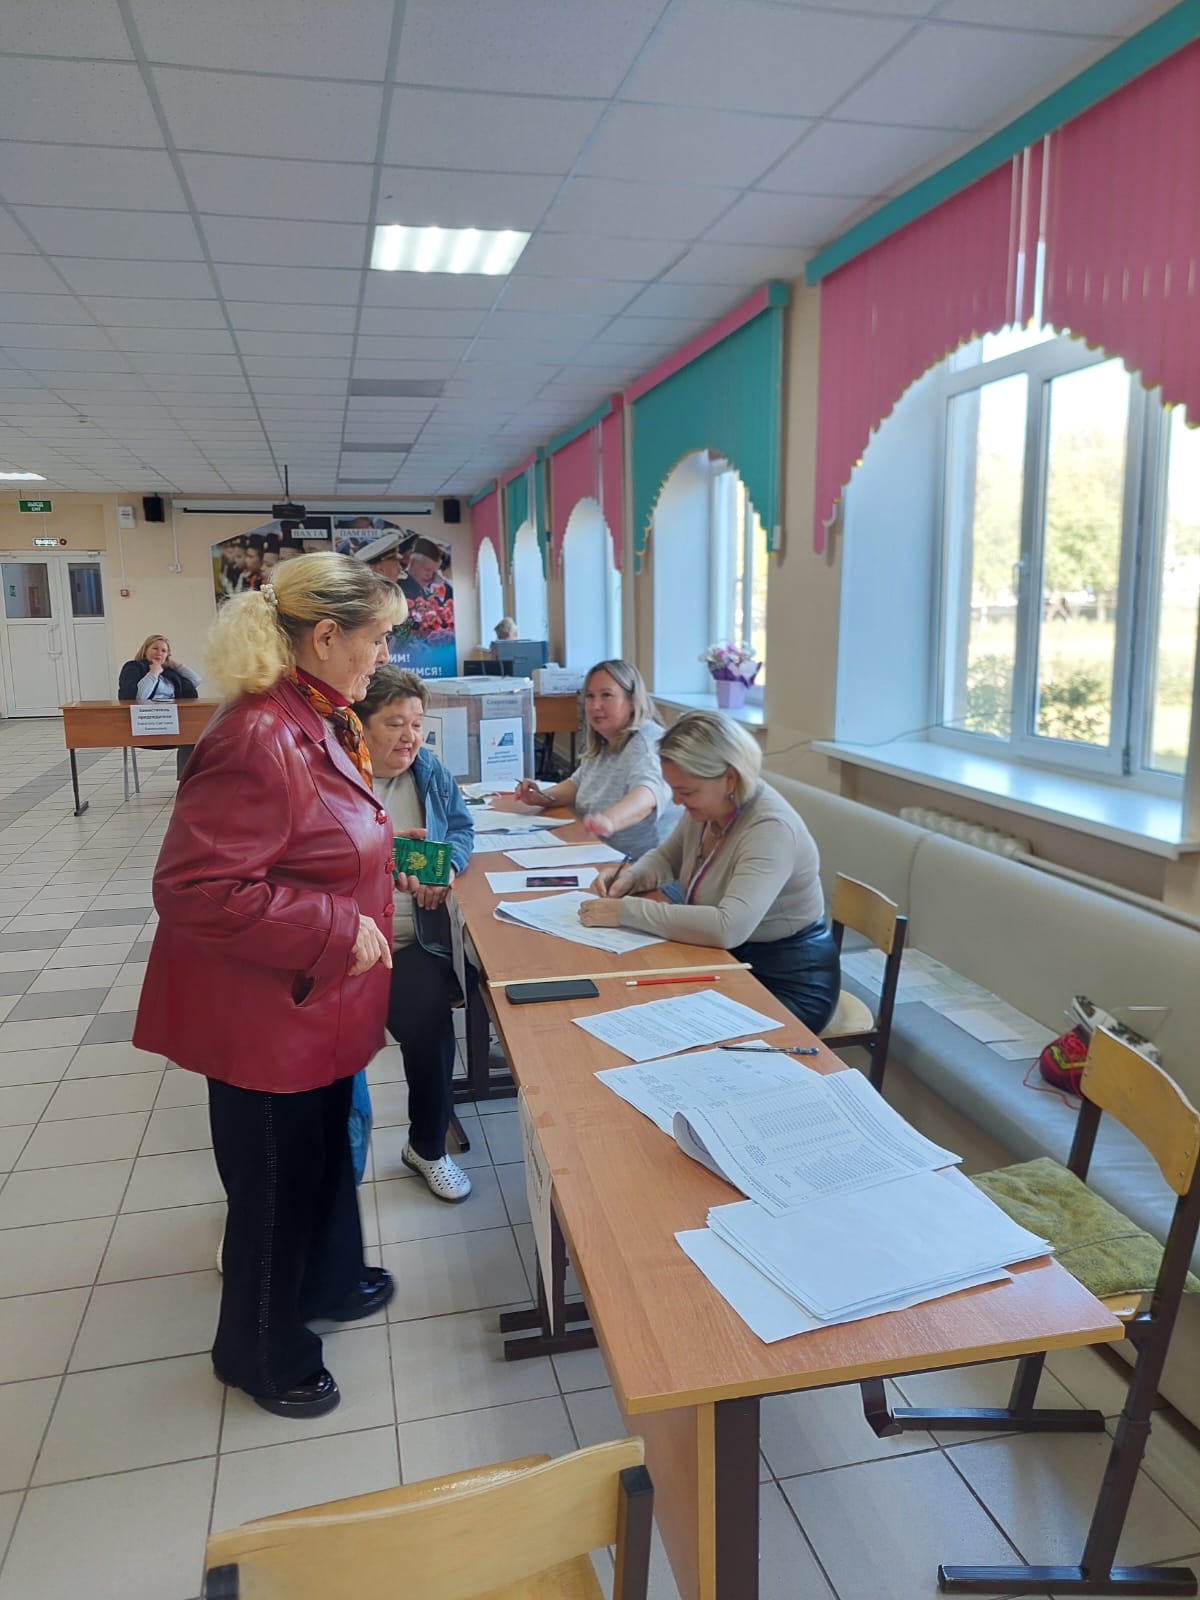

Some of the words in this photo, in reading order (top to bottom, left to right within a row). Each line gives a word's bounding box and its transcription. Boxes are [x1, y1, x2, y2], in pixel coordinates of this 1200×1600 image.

[293, 529, 325, 537] ВАХТА
[339, 529, 379, 537] ПАМЯТИ
[389, 653, 411, 663] ИМ!
